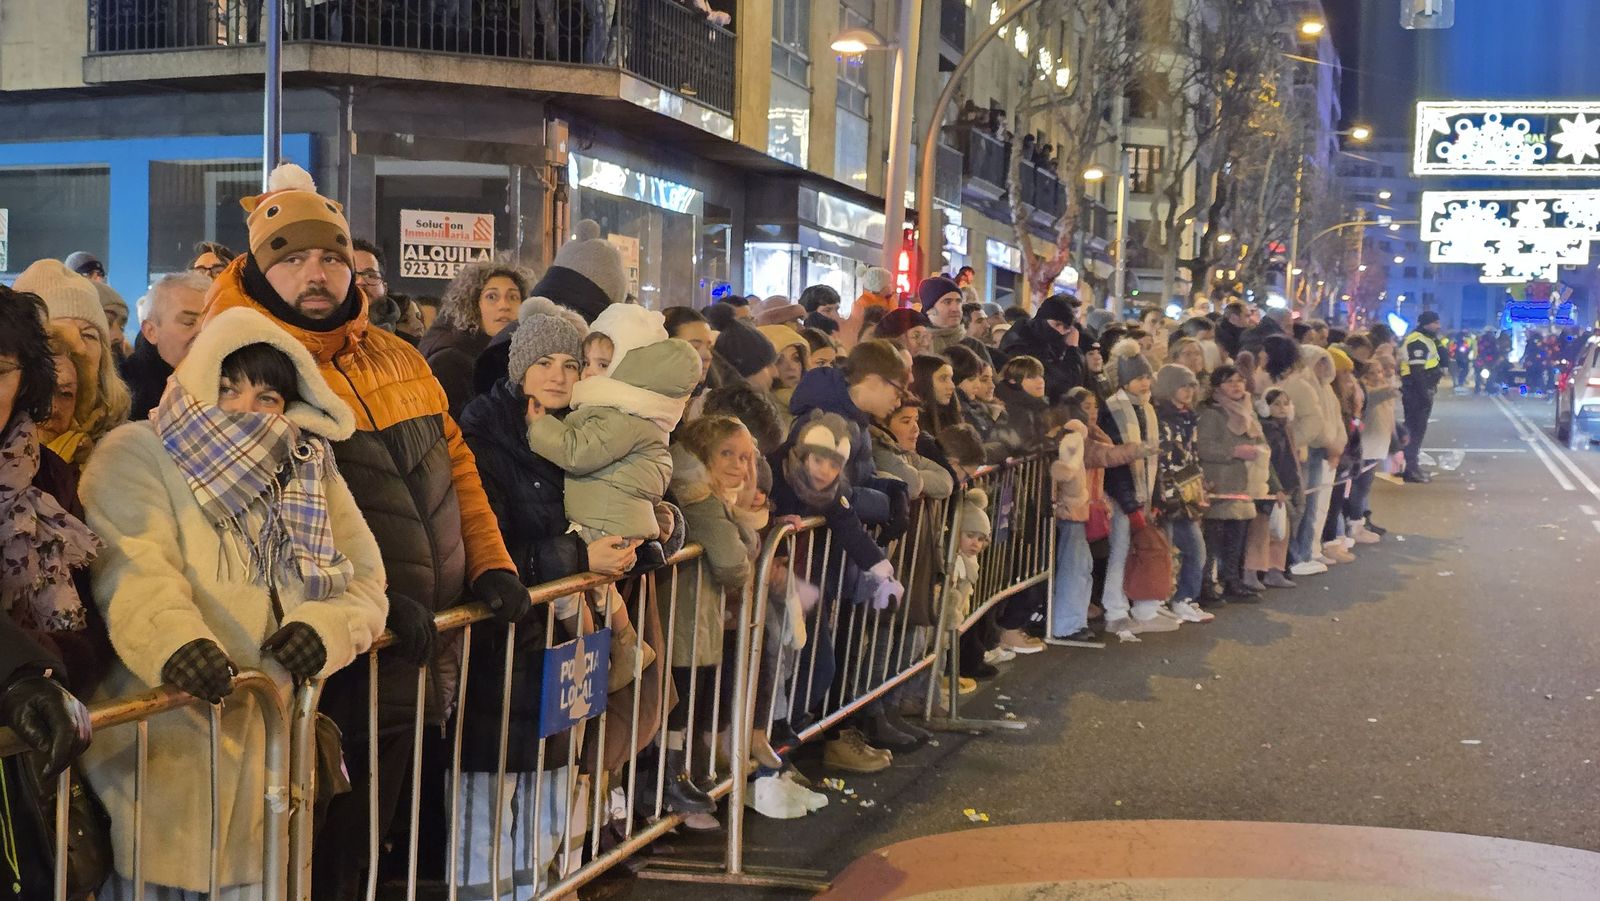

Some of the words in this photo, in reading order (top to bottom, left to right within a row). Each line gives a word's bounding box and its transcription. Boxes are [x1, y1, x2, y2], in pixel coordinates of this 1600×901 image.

[404, 245, 490, 262] ALQUILA
[404, 262, 429, 276] 923
[434, 263, 448, 277] 12
[560, 649, 600, 684] POCIA
